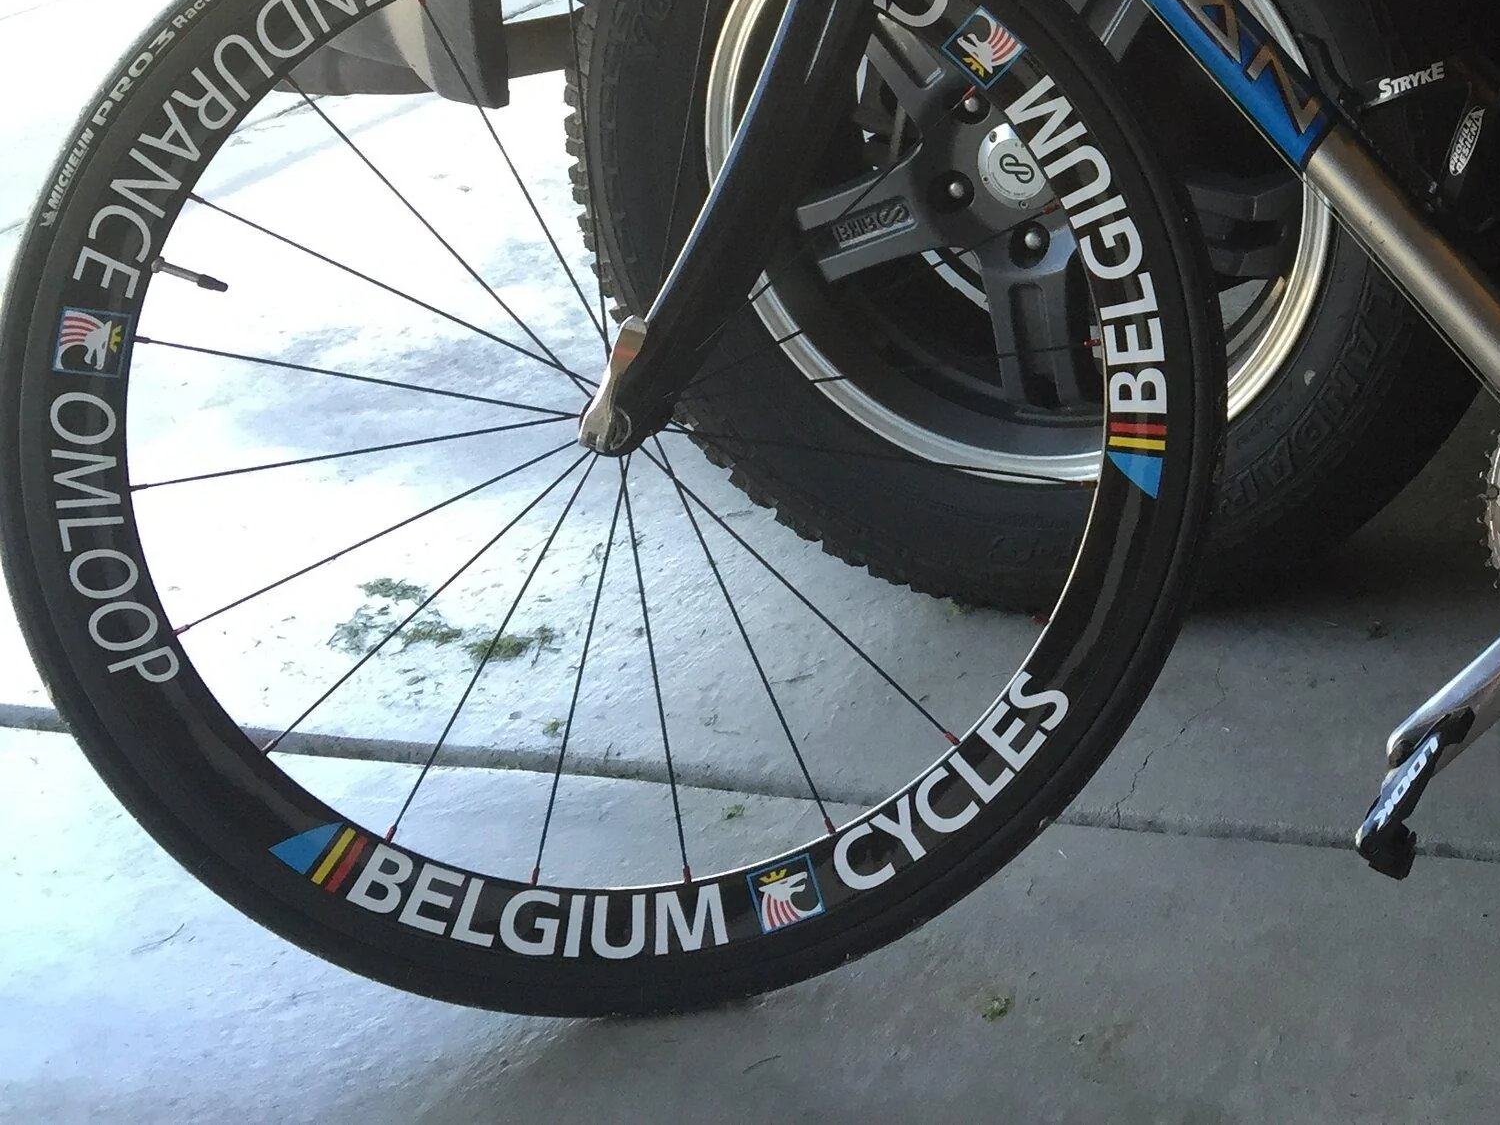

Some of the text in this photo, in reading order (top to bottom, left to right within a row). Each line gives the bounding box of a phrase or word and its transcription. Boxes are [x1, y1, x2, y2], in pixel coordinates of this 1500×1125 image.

[1378, 61, 1445, 99] STRYKE
[47, 127, 95, 210] MICHELIN
[1004, 74, 1168, 415] BELGIUM
[49, 391, 180, 684] OMLOOP
[832, 670, 1071, 892] CYCLES
[1375, 733, 1440, 831] LOOK
[346, 842, 728, 960] BELGIUM
